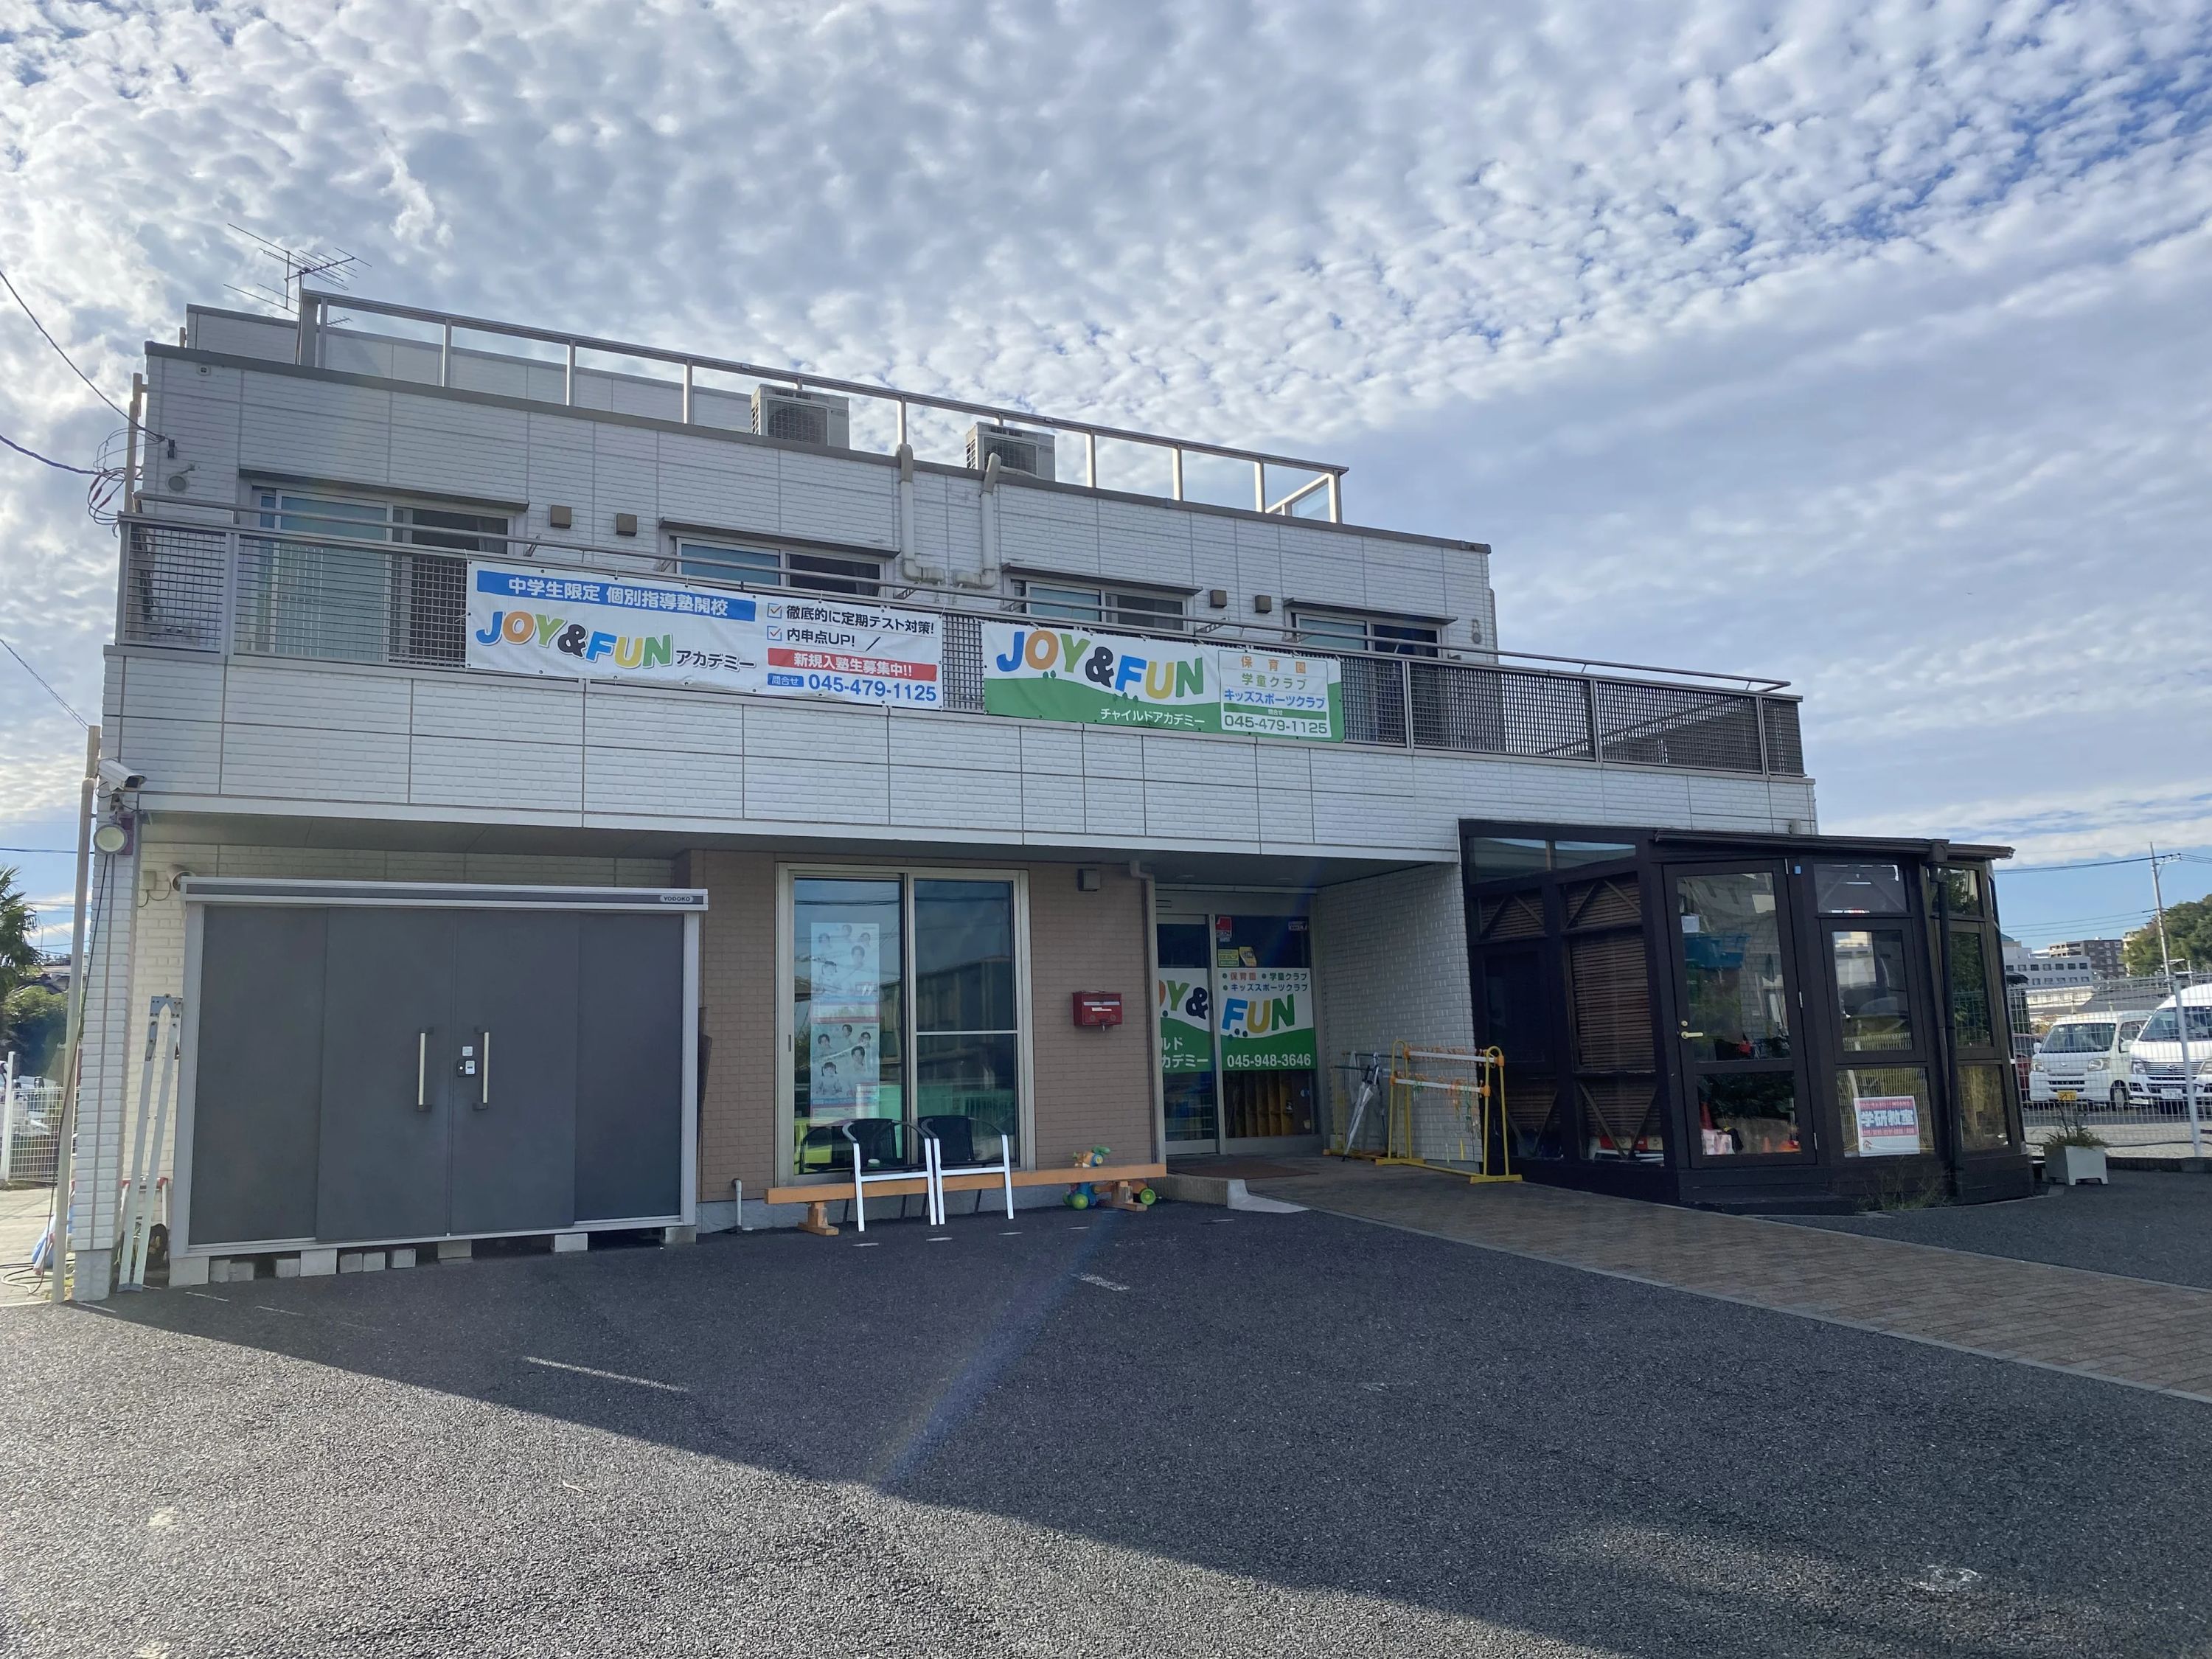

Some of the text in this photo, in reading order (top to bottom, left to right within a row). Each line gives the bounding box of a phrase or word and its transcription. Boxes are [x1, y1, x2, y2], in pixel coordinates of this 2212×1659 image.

[508, 577, 728, 616] 中学生限定 個別指導塾開校
[787, 605, 934, 634] 徹底的に定期テスト対策!
[476, 611, 672, 668] JOY&FUN
[787, 627, 855, 647] 内申点UP!
[676, 650, 755, 671] アカデミー
[794, 653, 912, 677] 新規入塾生募集中!!
[997, 630, 1204, 699] JOY&FUN
[1241, 655, 1306, 674] 保育園
[772, 674, 937, 701] 問合せ 045-479-1125
[1242, 673, 1307, 690] 学童クラブ
[1224, 689, 1326, 709] キッズスポーツクラブ
[1100, 708, 1206, 726] チャイルドアカデミー
[1224, 714, 1328, 734] 045-479-1125
[1231, 983, 1309, 992] キッズスポーツクラブ
[1222, 993, 1295, 1033] FUN
[1227, 1054, 1311, 1068] 045-948-3646
[1860, 1109, 1915, 1127] 学研教室
